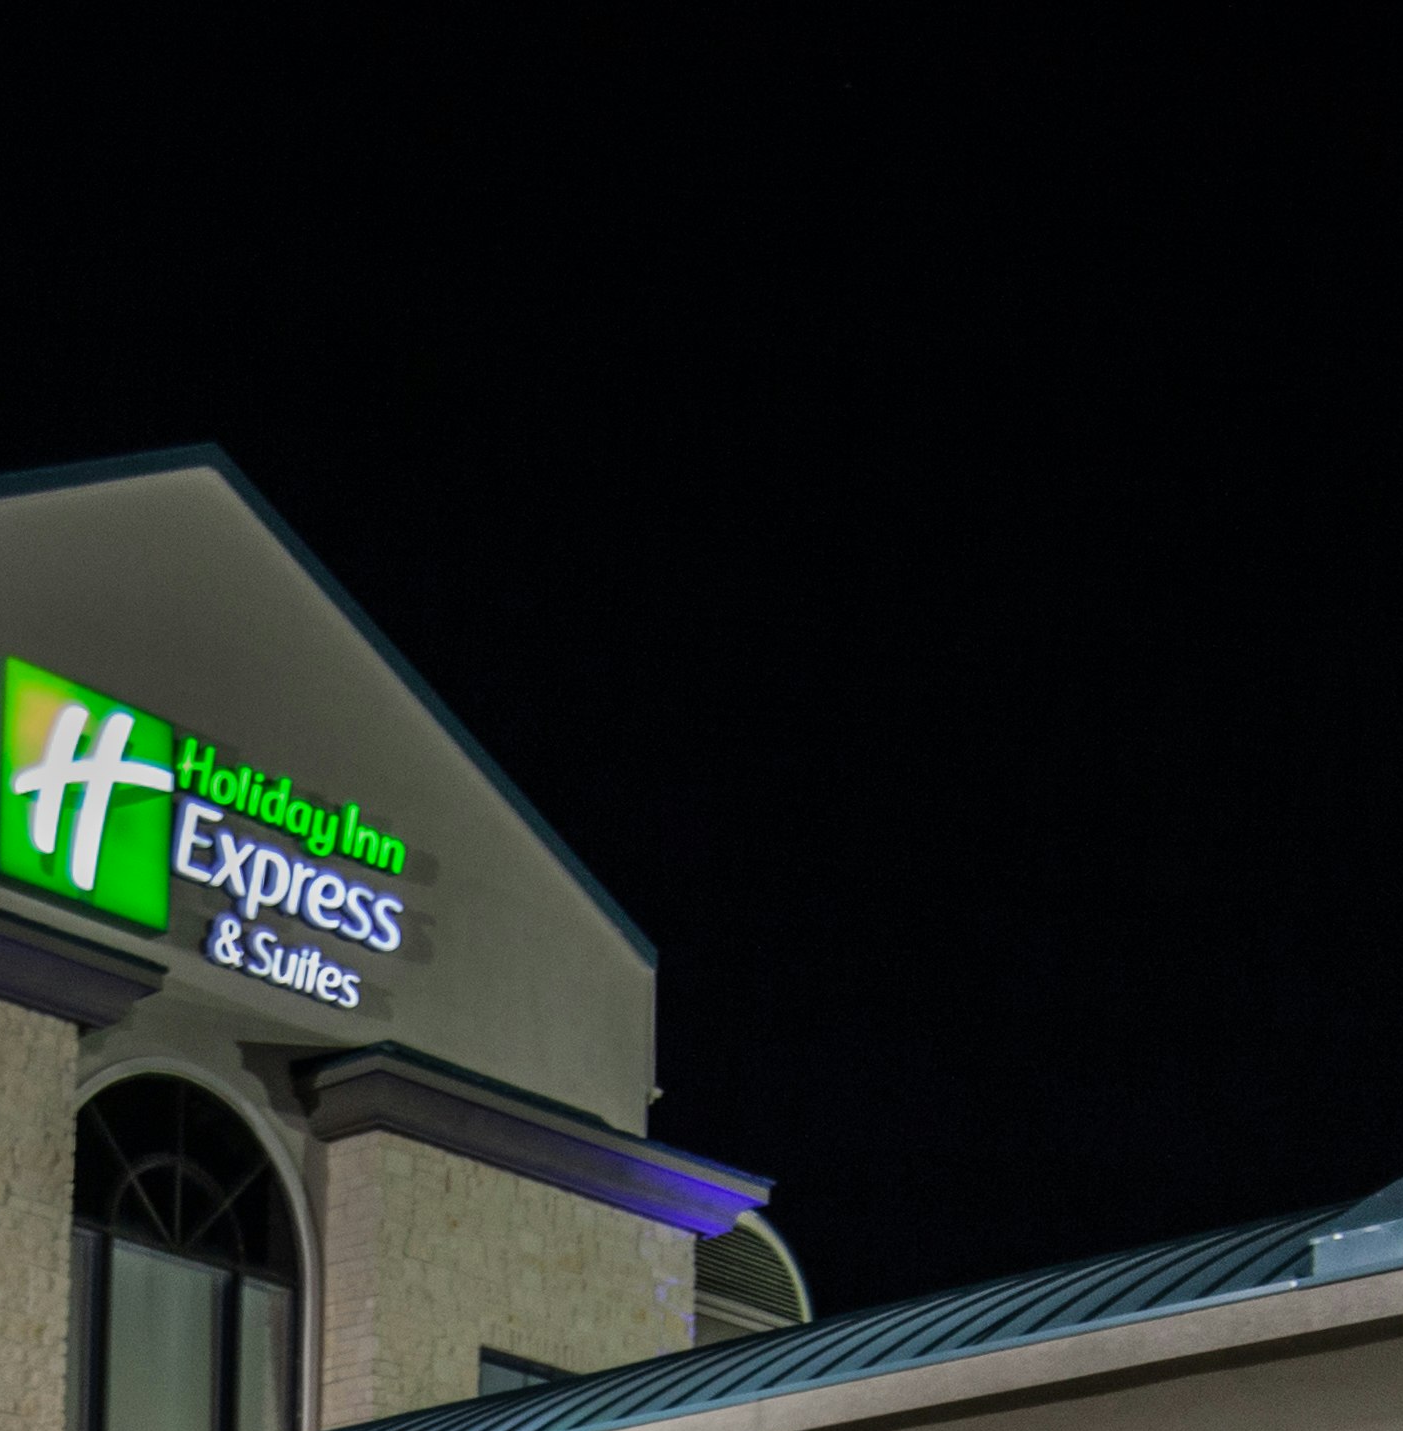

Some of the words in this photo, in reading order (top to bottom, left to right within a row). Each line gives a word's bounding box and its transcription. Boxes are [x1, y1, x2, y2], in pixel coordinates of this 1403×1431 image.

[178, 736, 339, 857] Holiday
[342, 803, 406, 875] Inn
[174, 801, 404, 953] Express
[213, 917, 244, 968] &
[248, 931, 362, 1009] Suites
